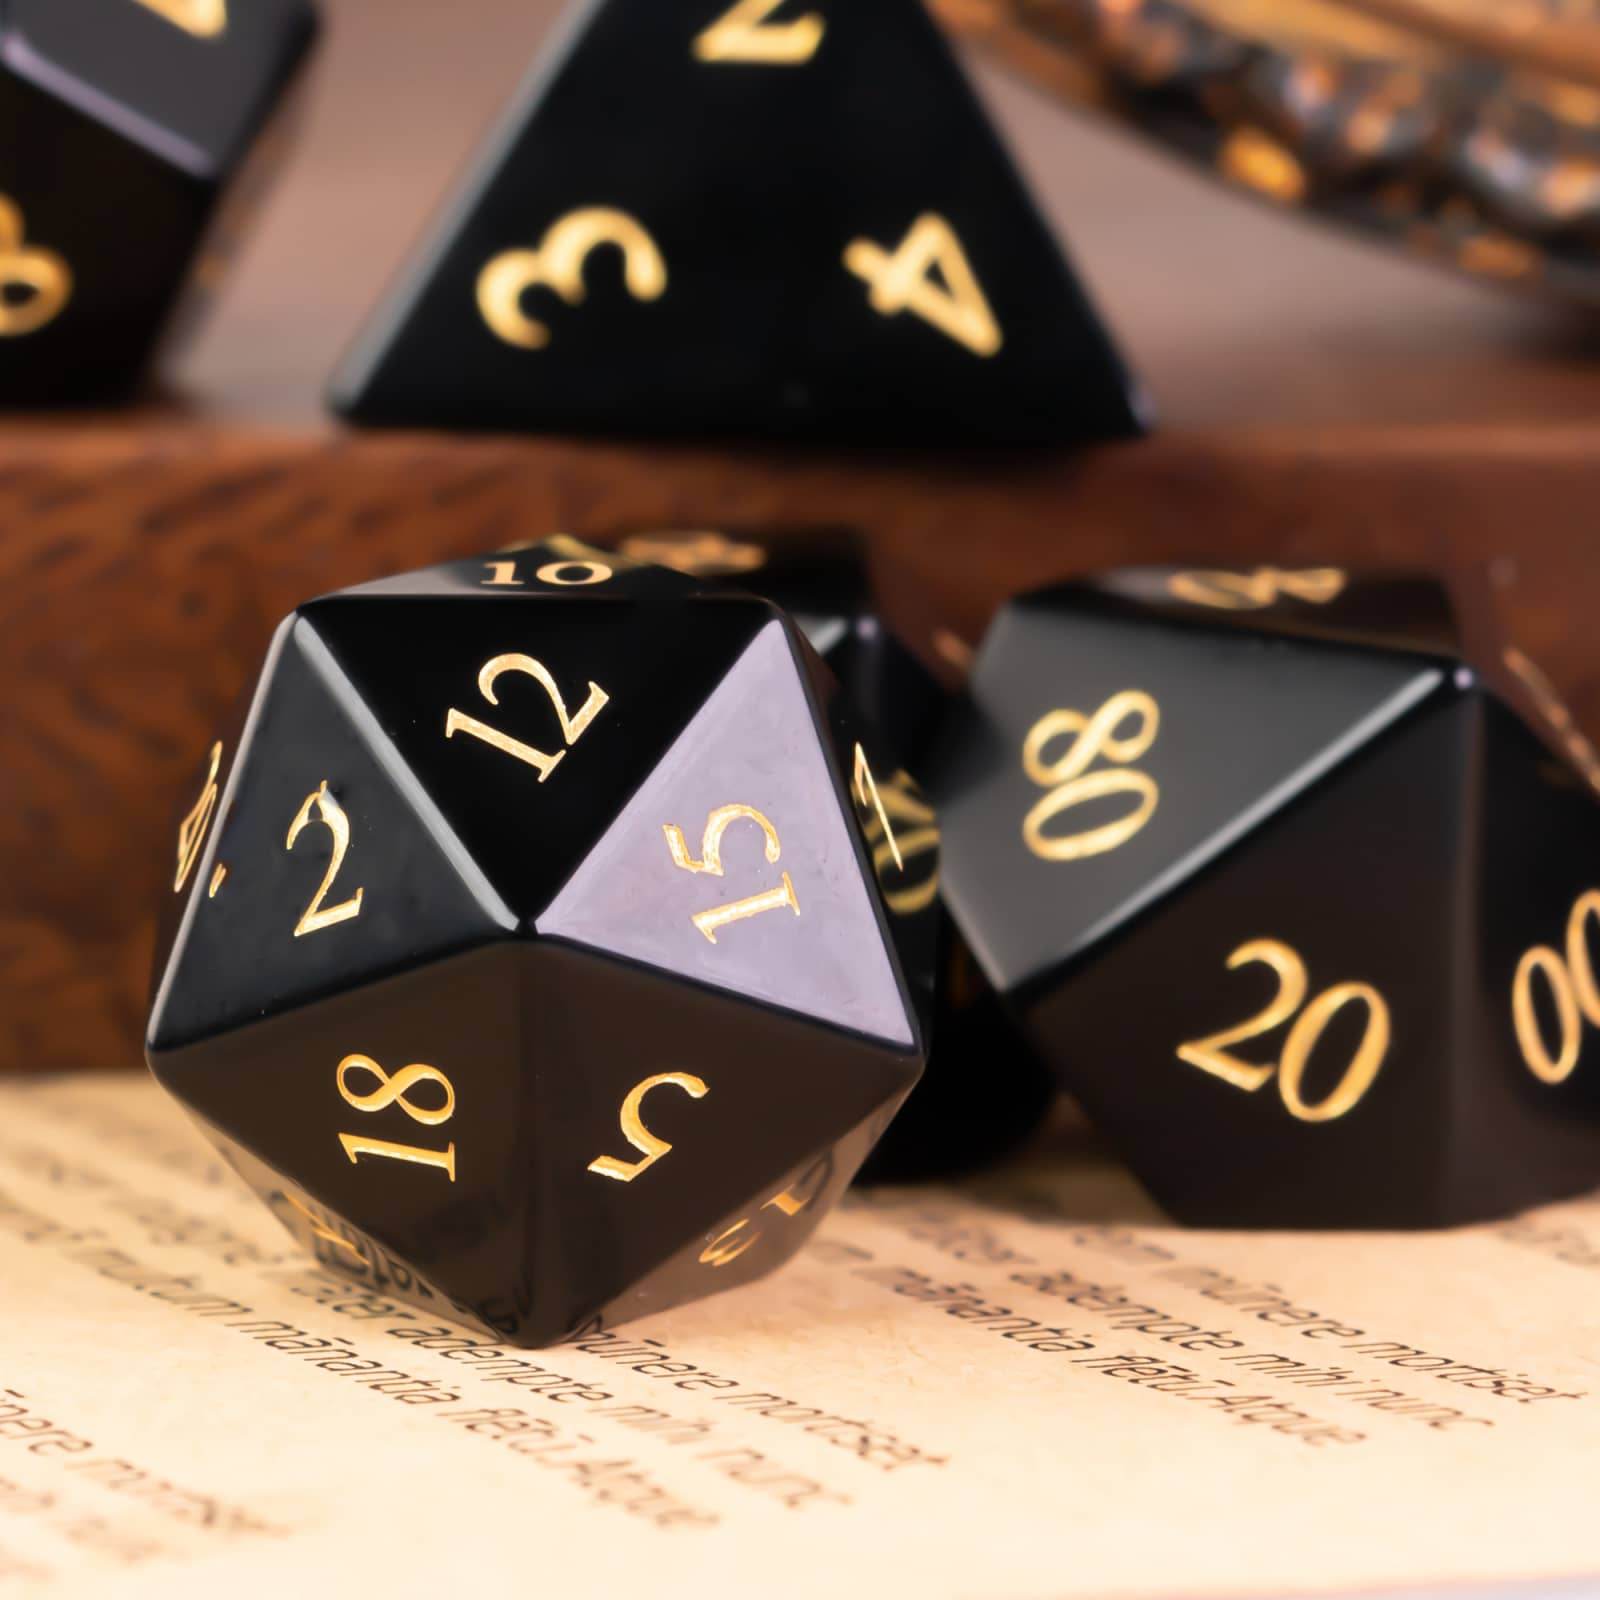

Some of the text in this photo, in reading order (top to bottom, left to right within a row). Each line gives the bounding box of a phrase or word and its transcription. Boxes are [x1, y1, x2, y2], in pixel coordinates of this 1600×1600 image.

[476, 206, 668, 350] 3
[845, 211, 1002, 358] 4
[480, 560, 613, 586] 10
[445, 652, 610, 784] 12
[1022, 688, 1160, 862] 80
[286, 779, 364, 938] 2
[662, 803, 801, 945] 15
[1176, 938, 1392, 1123] 20
[336, 1053, 457, 1184] 18
[587, 1071, 710, 1183] 5
